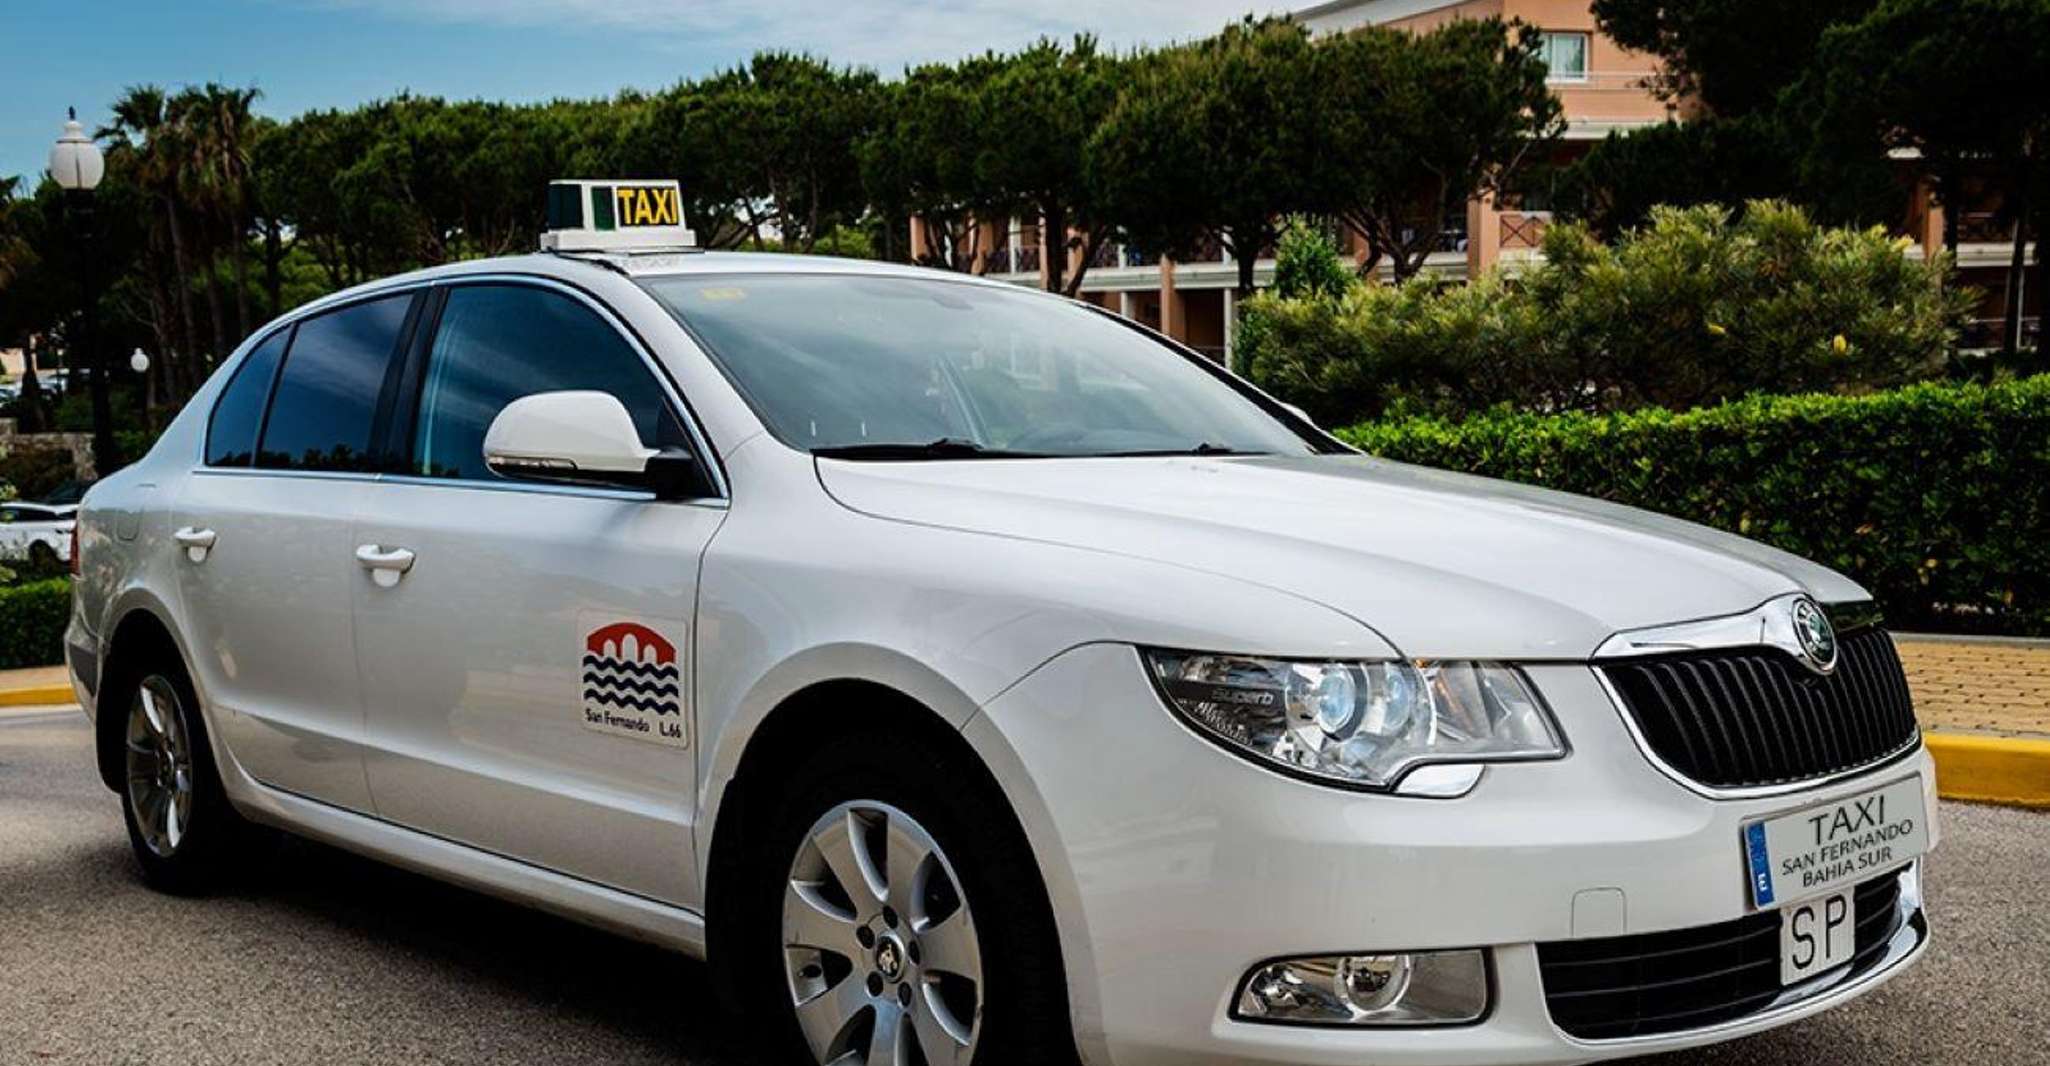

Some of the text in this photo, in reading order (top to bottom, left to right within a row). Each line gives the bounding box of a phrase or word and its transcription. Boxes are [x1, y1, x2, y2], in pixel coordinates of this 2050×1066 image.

[617, 189, 677, 224] TAXI
[585, 707, 603, 723] San
[604, 710, 650, 732] Fernando
[1809, 794, 1886, 846] TAXI
[1782, 819, 1913, 876] SAN FERNANDO
[1802, 846, 1893, 888] BAHIA SUR
[1791, 893, 1847, 970] SP
